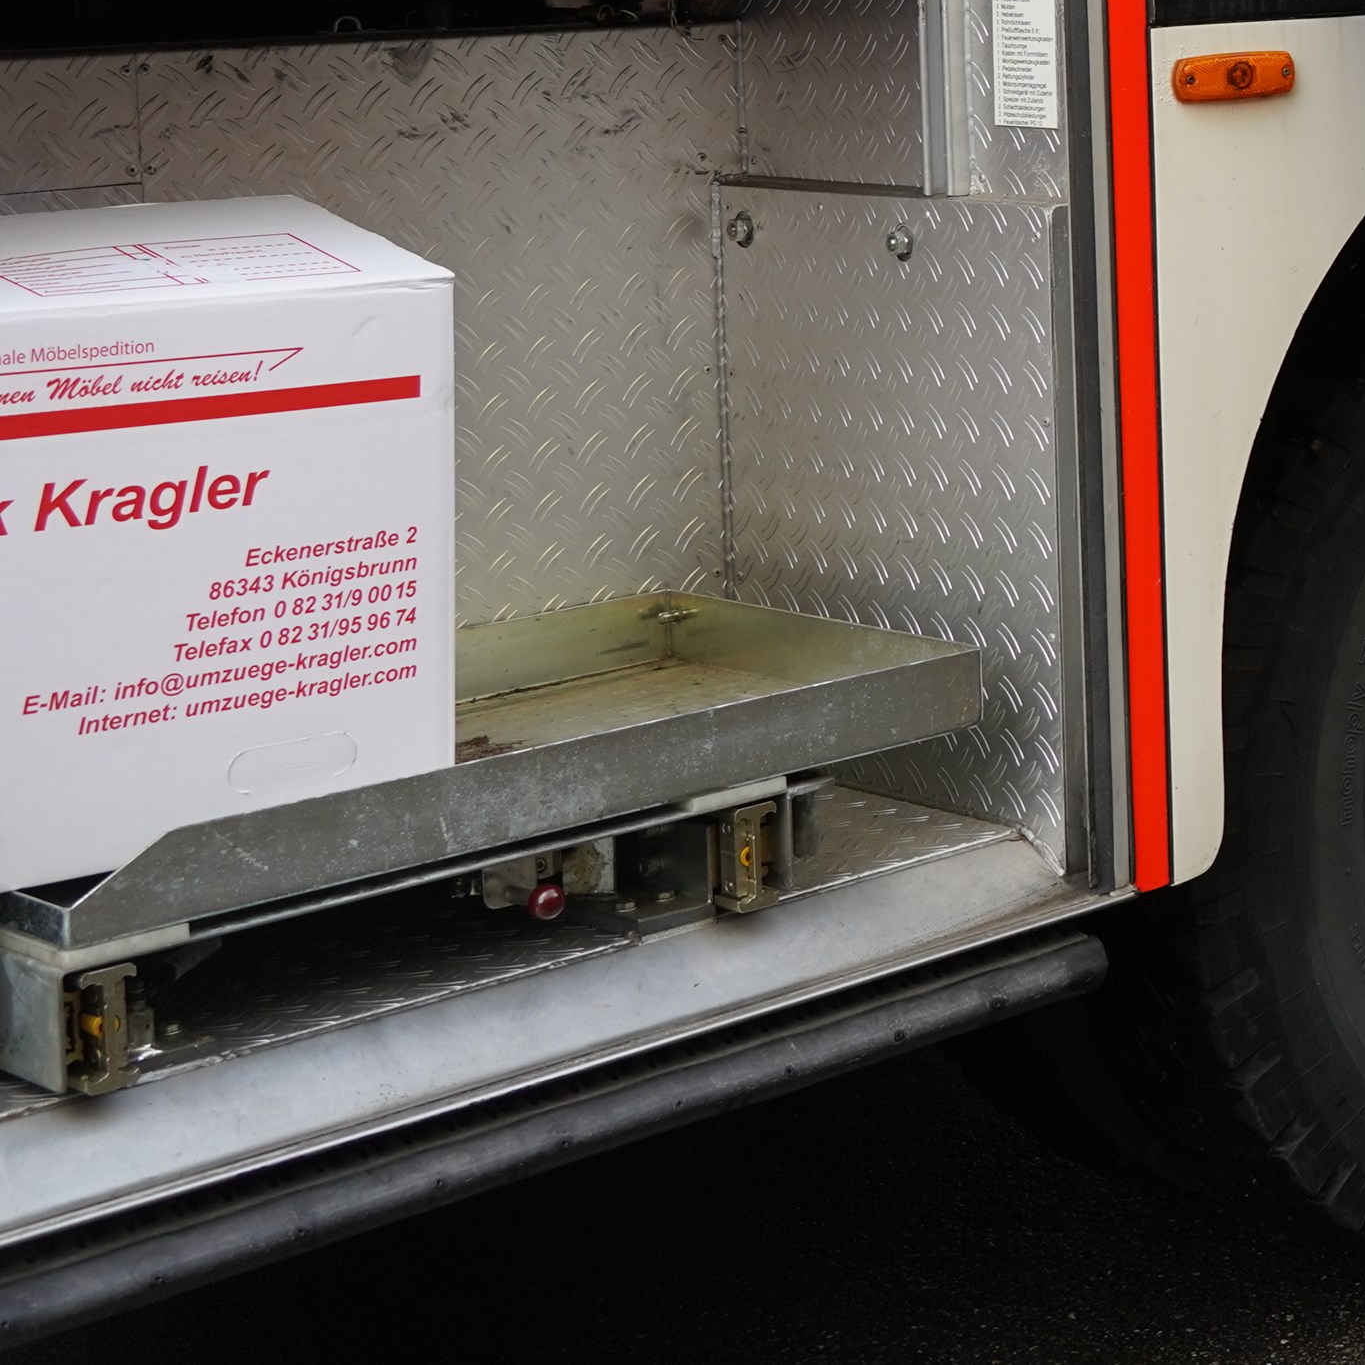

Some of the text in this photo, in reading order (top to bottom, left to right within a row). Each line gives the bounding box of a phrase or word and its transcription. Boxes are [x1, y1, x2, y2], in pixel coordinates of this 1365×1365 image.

[0, 340, 155, 365] ale Möbelspedition
[46, 374, 123, 401] Möbel
[130, 369, 185, 393] nicht
[191, 360, 264, 386] reisen!
[33, 464, 271, 533] Kragler
[244, 526, 418, 568] Eckenerstraße 2
[208, 556, 418, 600] 86343 Königsbrunn
[185, 605, 266, 632] Telefon
[274, 600, 286, 619] 0
[290, 595, 317, 616] 82
[321, 588, 364, 612] 31/9
[174, 607, 418, 663] Telefax 0 82 31/95 96 74
[22, 636, 418, 716] E-Mail: info@umzuege-kragler.com
[78, 664, 418, 736] Internet: umzuege-kragler.com
